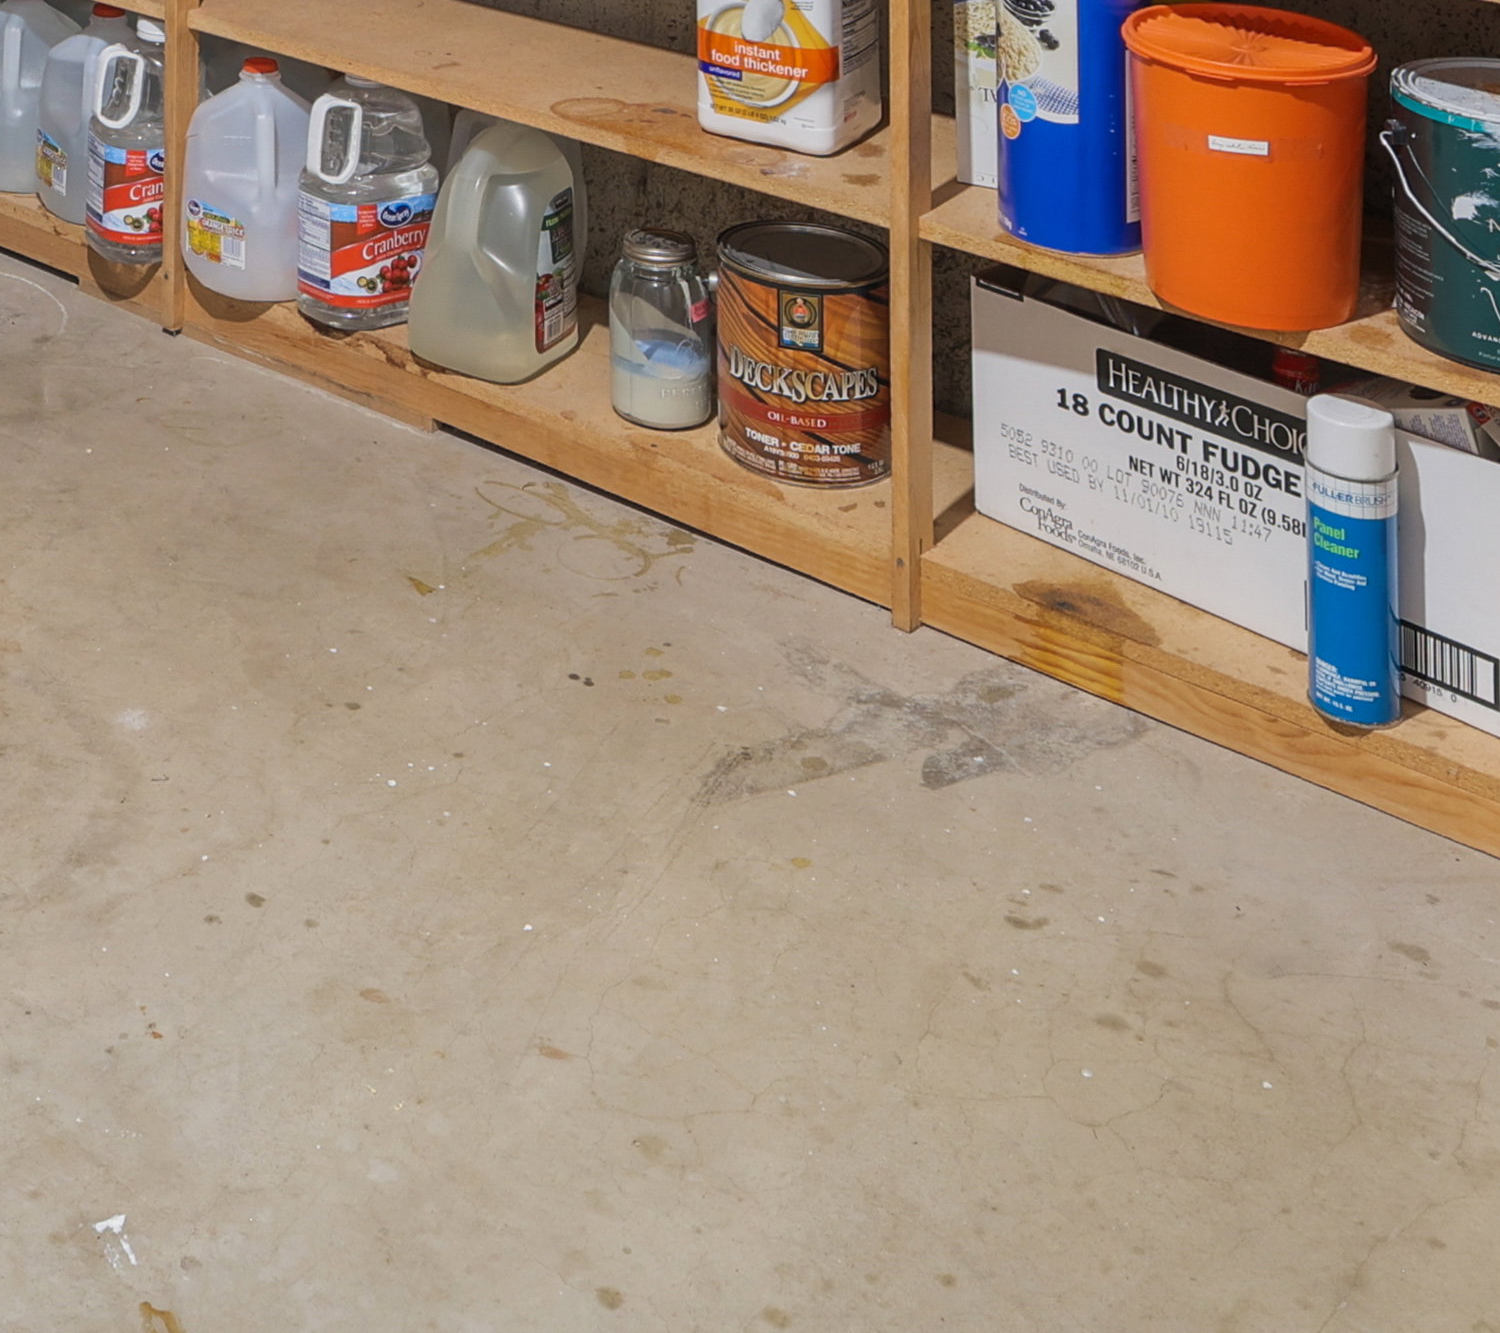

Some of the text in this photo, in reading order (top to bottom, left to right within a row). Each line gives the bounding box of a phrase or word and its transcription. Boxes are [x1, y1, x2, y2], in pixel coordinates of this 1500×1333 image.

[712, 50, 808, 78] food thickener
[735, 42, 781, 61] instant
[362, 228, 426, 260] Cranberry
[729, 346, 878, 403] DECKSCAPES
[1108, 358, 1217, 423] HEALTHY
[768, 411, 827, 428] OIL-BASED
[745, 427, 861, 455] TONER CEDAR TONE
[1056, 387, 1302, 497] 18 COUNT FUDGE
[1129, 455, 1258, 520] NET WT 324 FL OZ
[1177, 456, 1263, 502] 6/18/3.0 OZ
[1313, 516, 1345, 541] Panel
[1313, 532, 1360, 561] Cleaner
